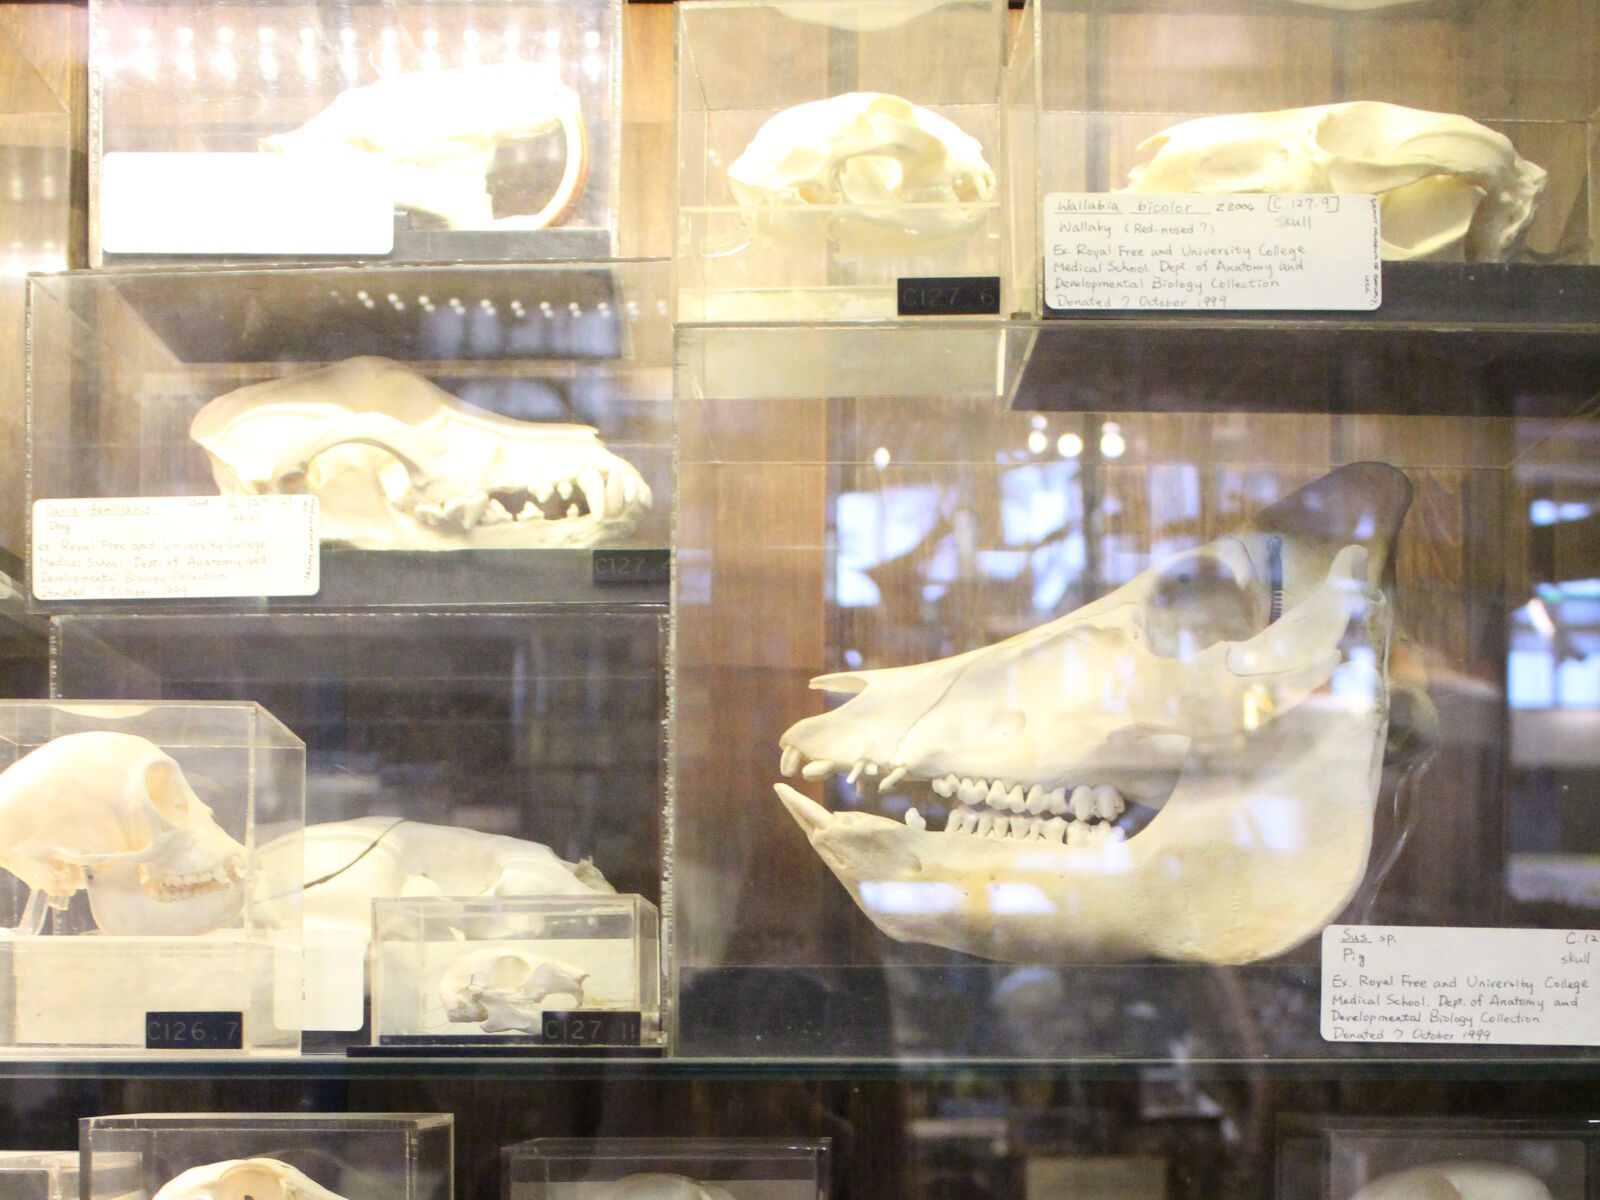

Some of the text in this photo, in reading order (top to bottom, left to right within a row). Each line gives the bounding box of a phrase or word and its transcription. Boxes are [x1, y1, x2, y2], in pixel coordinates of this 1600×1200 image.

[1058, 200, 1119, 212] Wallabia
[1138, 201, 1192, 212] bicolor
[1059, 221, 1111, 238] Wallaby
[1076, 243, 1305, 261] Royal Free and University College
[1053, 259, 1303, 278] Medical Anatomy and
[1152, 276, 1202, 295] Biology
[1211, 279, 1280, 289] Collection
[1057, 295, 1111, 307] Donated
[1139, 295, 1187, 307] October
[1343, 929, 1368, 942] Sus
[1380, 935, 1396, 946] sp.
[1343, 948, 1590, 967] Pig skull
[1360, 975, 1393, 988] Royal
[1402, 975, 1427, 988] Free
[1433, 977, 1456, 988] and
[1467, 976, 1533, 995] University
[1545, 976, 1589, 994] College
[1333, 994, 1578, 1012] Medical School. Dept. of Anatomy and
[1331, 1009, 1539, 1028] Developmental Biology Collection
[149, 1022, 238, 1040] C126.7
[1334, 1027, 1490, 1040] Donated October 1999
